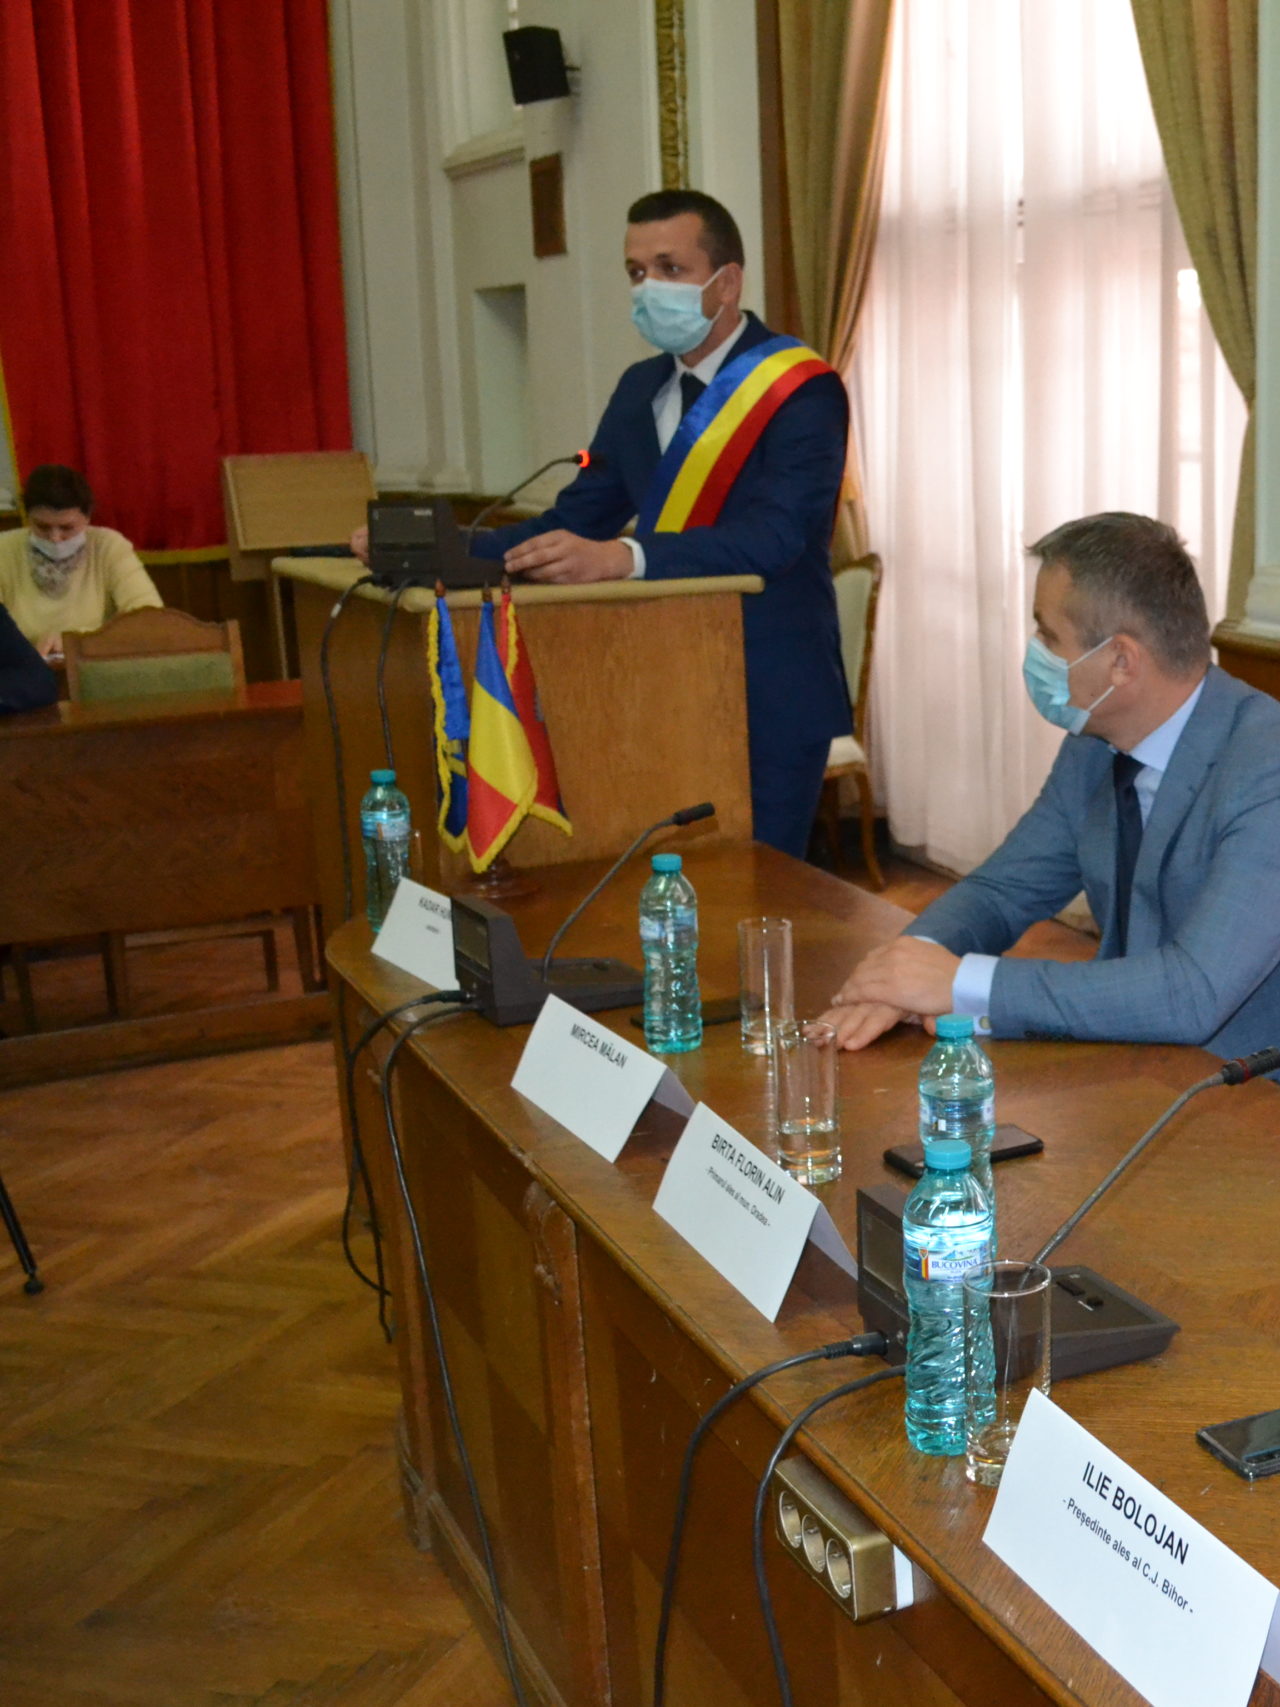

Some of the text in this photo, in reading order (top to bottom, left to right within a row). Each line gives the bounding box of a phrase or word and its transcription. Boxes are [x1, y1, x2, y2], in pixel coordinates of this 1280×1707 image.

[571, 1023, 600, 1052] MIRCEA
[711, 1133, 786, 1205] BIRTA FLORIN ALIN
[750, 1204, 768, 1226] Oradea
[931, 1259, 978, 1270] BUCOVINA
[1082, 1461, 1190, 1566] ILIE BOLOJAN
[1112, 1541, 1132, 1562] ales
[1132, 1556, 1143, 1572] al
[1142, 1563, 1160, 1588] C.J.
[1161, 1578, 1189, 1611] Bihor
